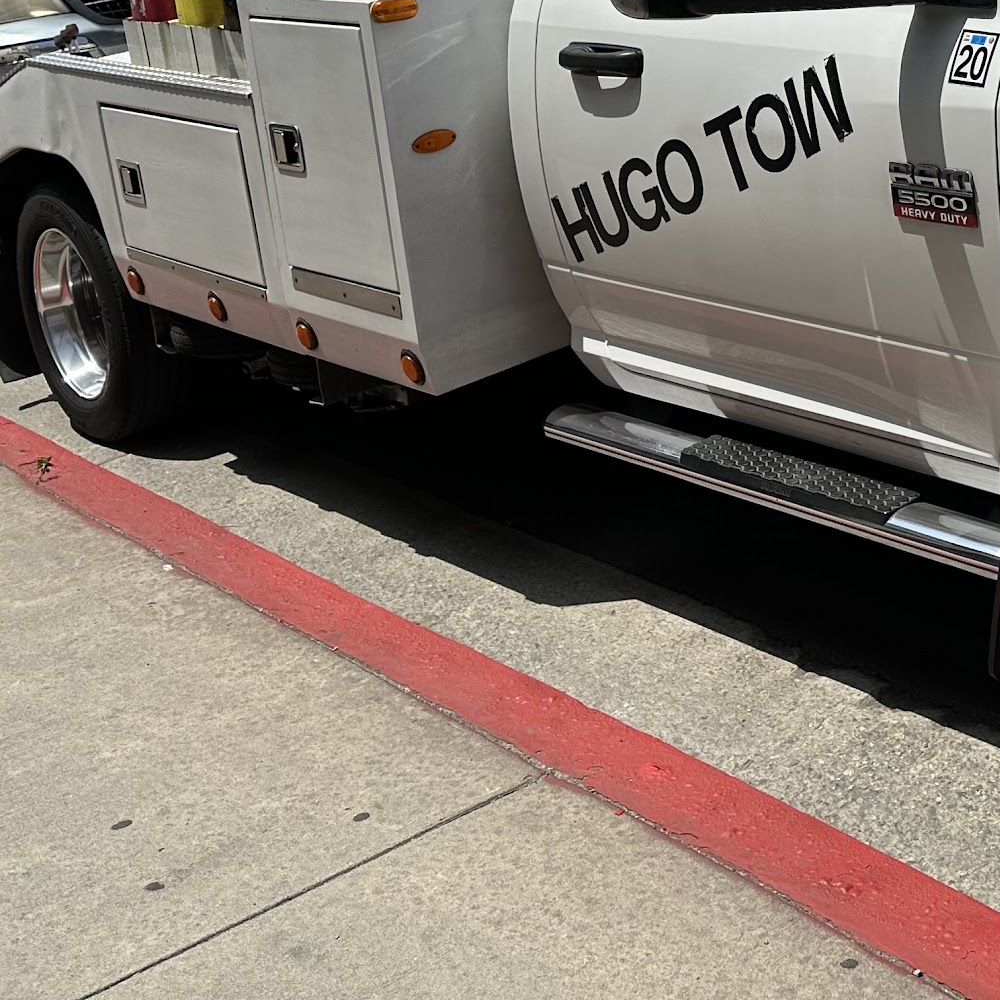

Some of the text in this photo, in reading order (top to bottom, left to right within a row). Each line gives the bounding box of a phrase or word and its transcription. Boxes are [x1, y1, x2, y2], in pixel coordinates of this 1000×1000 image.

[953, 44, 988, 81] 20
[551, 54, 854, 263] HUGO TOW
[897, 188, 968, 212] 5500
[901, 206, 968, 226] HEAVY DUTY
